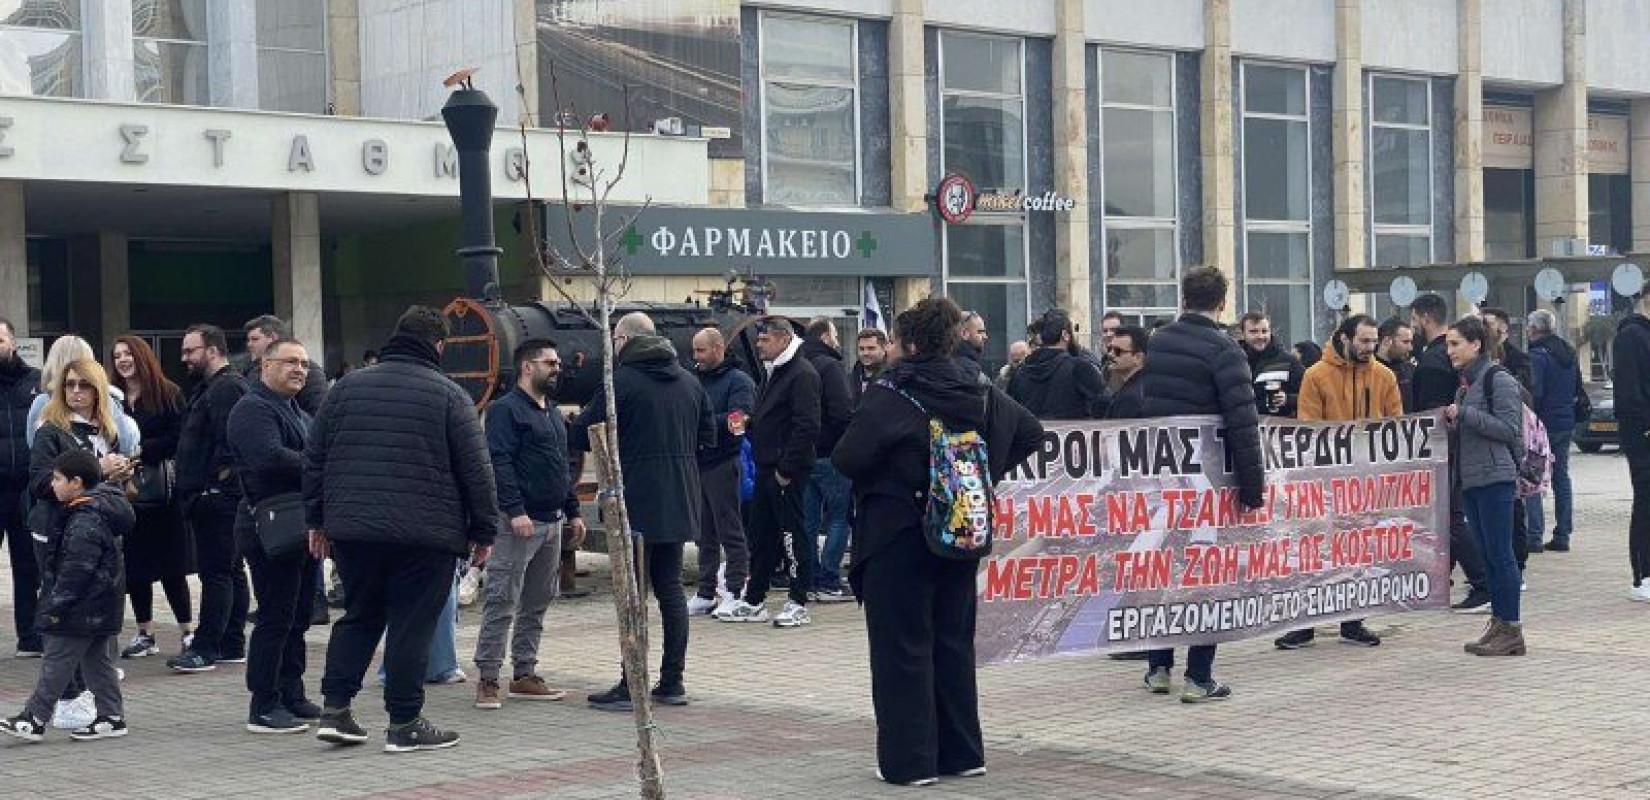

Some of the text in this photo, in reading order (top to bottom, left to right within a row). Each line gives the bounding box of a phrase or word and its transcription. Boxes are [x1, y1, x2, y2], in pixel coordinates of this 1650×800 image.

[1023, 191, 1074, 211] coffee
[651, 226, 851, 259] ΦΑΡΜΑΚΕΙΟ
[1119, 426, 1202, 478] ΜΑΣ
[1259, 423, 1355, 472] ΚΕΡΔΗ
[1364, 417, 1435, 464] ΤΟΥΣ
[1027, 493, 1097, 538] ΜΑΣ
[1105, 491, 1151, 534] ΝΑ
[1283, 479, 1325, 519] ΤΗΝ
[1331, 471, 1431, 515] ΠΟΛΙΤΙΚΗ
[984, 523, 1414, 602] ΜΕΤΡΑ ΤΗΝ ΖΩΗ ΜΑΣ ΩΣ ΚΟΣΤΟΣ
[1108, 572, 1430, 641] ΕΡΓΑΖΟΜΕΝΟΙ ΣΤΟ ΣΙΔΗΡΟΔΡΟΜΟ
